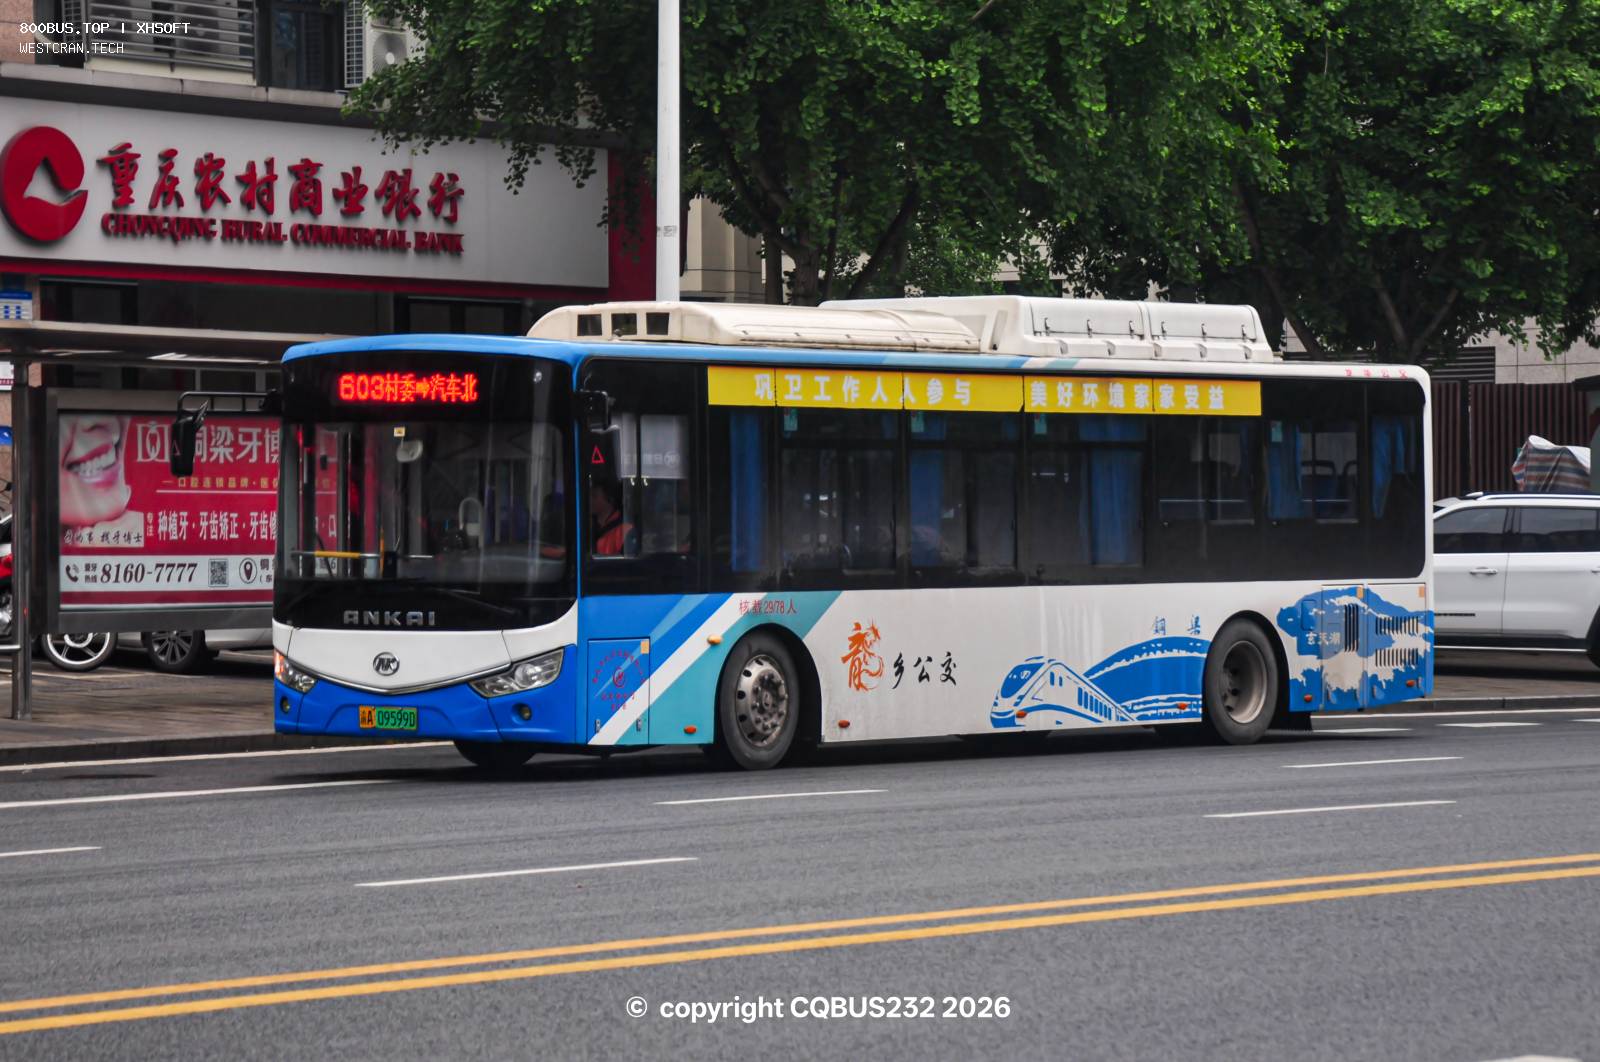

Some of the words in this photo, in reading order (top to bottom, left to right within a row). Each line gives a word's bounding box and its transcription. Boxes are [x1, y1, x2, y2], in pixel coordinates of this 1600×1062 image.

[101, 212, 217, 246] CHONGQING
[221, 218, 288, 243] RURAL
[290, 222, 412, 251] COMMERCIAL
[414, 231, 464, 255] BANK
[100, 562, 198, 584] 8160-7777
[343, 610, 435, 626] ANKAI
